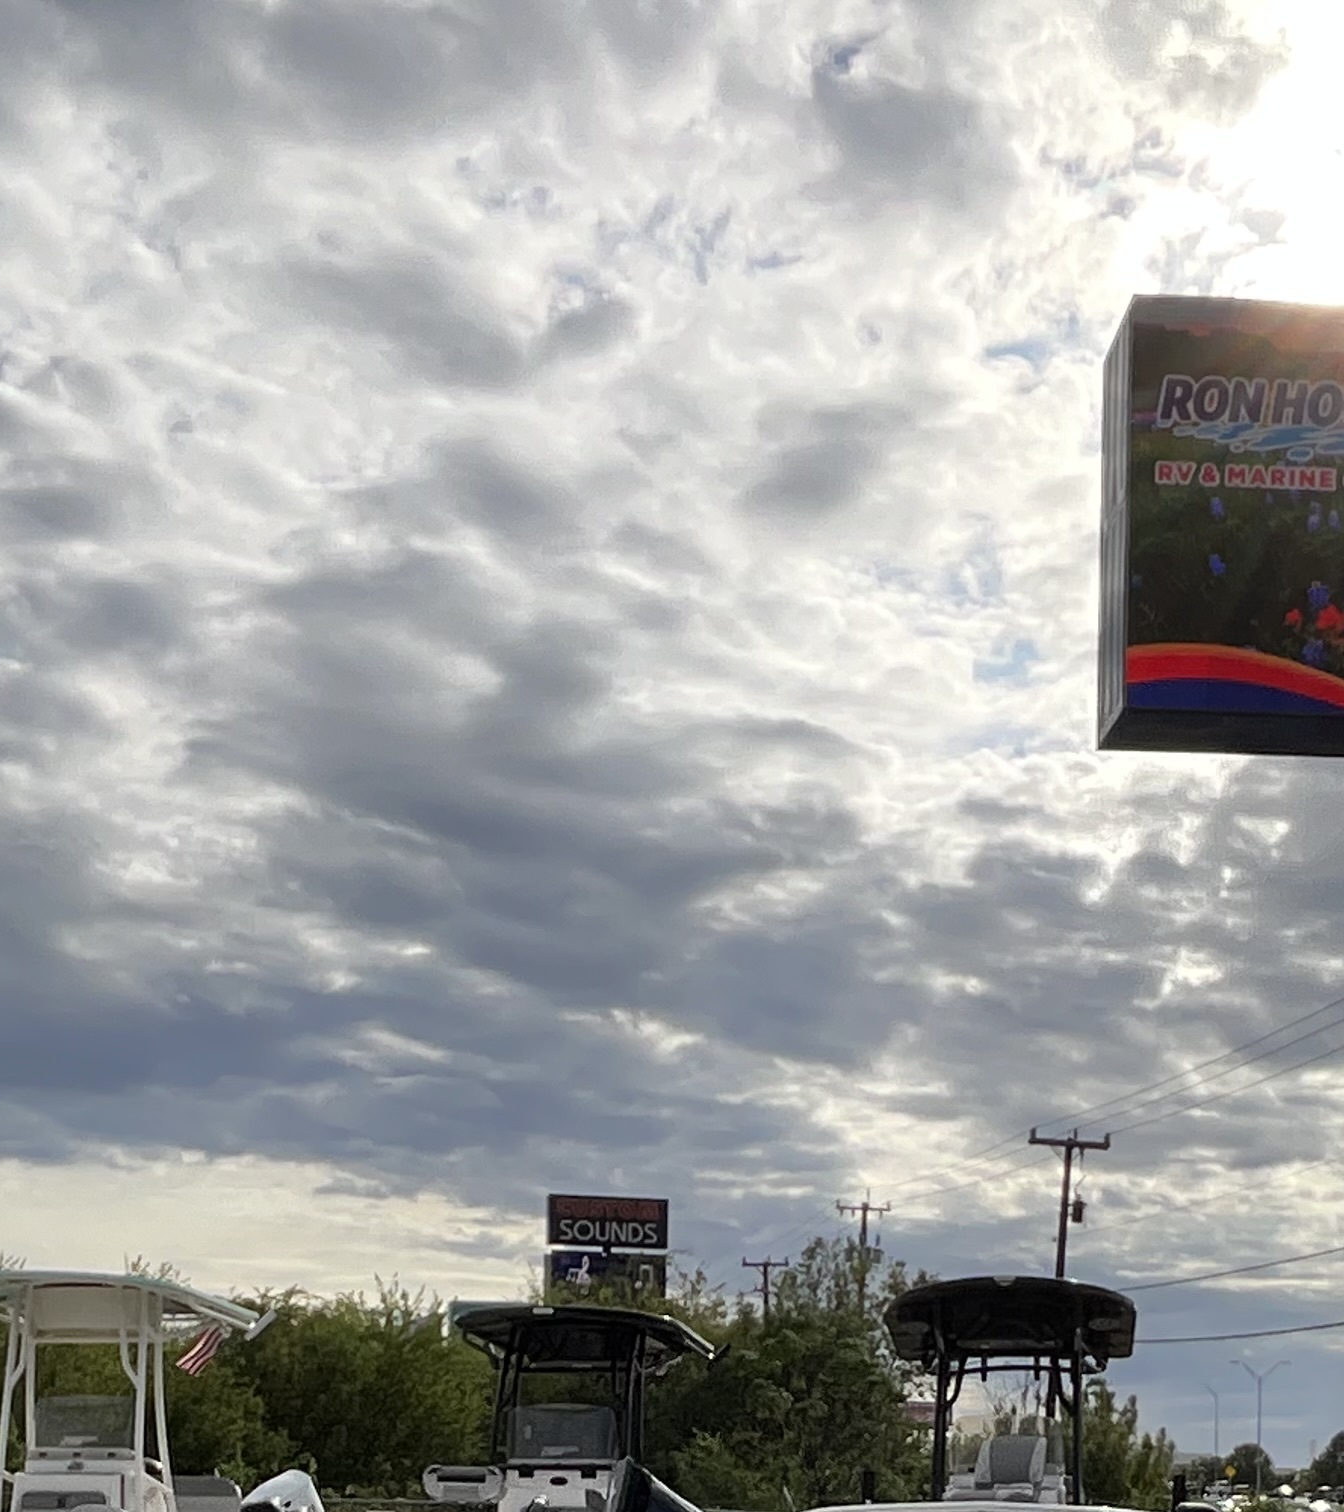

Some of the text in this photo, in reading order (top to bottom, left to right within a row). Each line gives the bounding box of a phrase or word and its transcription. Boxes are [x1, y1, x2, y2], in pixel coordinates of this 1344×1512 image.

[1158, 374, 1267, 429] RON
[1155, 460, 1197, 485] RV
[1200, 461, 1221, 487] &
[1225, 464, 1336, 492] MARINE
[559, 1219, 658, 1244] SOUNDS
